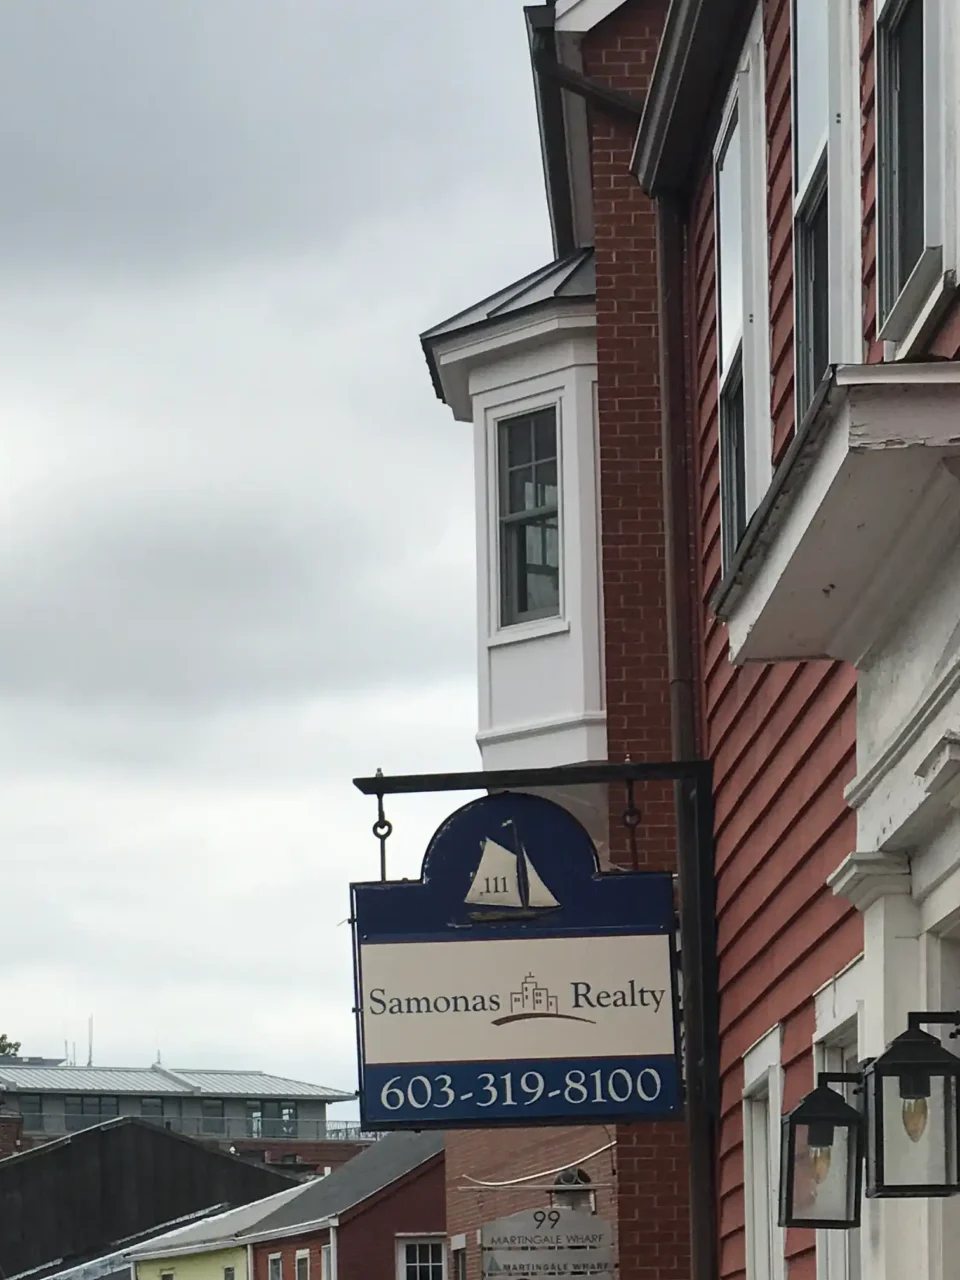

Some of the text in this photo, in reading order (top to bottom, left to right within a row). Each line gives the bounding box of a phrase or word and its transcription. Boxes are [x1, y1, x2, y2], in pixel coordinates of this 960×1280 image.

[484, 876, 509, 894] 111
[369, 979, 666, 1016] Samonas Realty
[380, 1067, 662, 1111] 603-319-8100
[533, 1210, 561, 1230] 99
[490, 1233, 604, 1245] MARTINGALE WHARF
[502, 1262, 609, 1272] MARTINGALE WHARF
